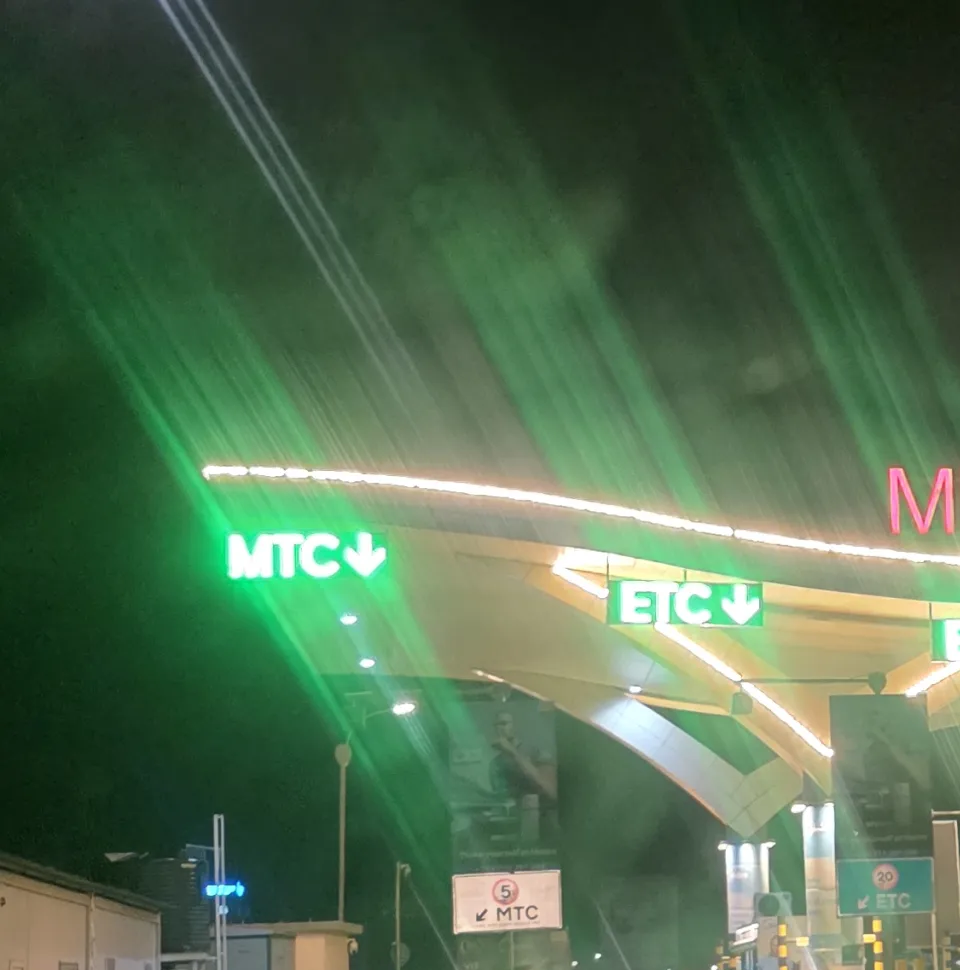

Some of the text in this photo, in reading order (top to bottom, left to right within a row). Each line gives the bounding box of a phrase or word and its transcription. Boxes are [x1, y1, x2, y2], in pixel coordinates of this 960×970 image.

[226, 532, 341, 579] MTC
[617, 581, 713, 626] ETC
[876, 871, 894, 885] 20
[499, 884, 512, 899] 5
[875, 892, 912, 910] ETC
[496, 904, 539, 922] MTC
